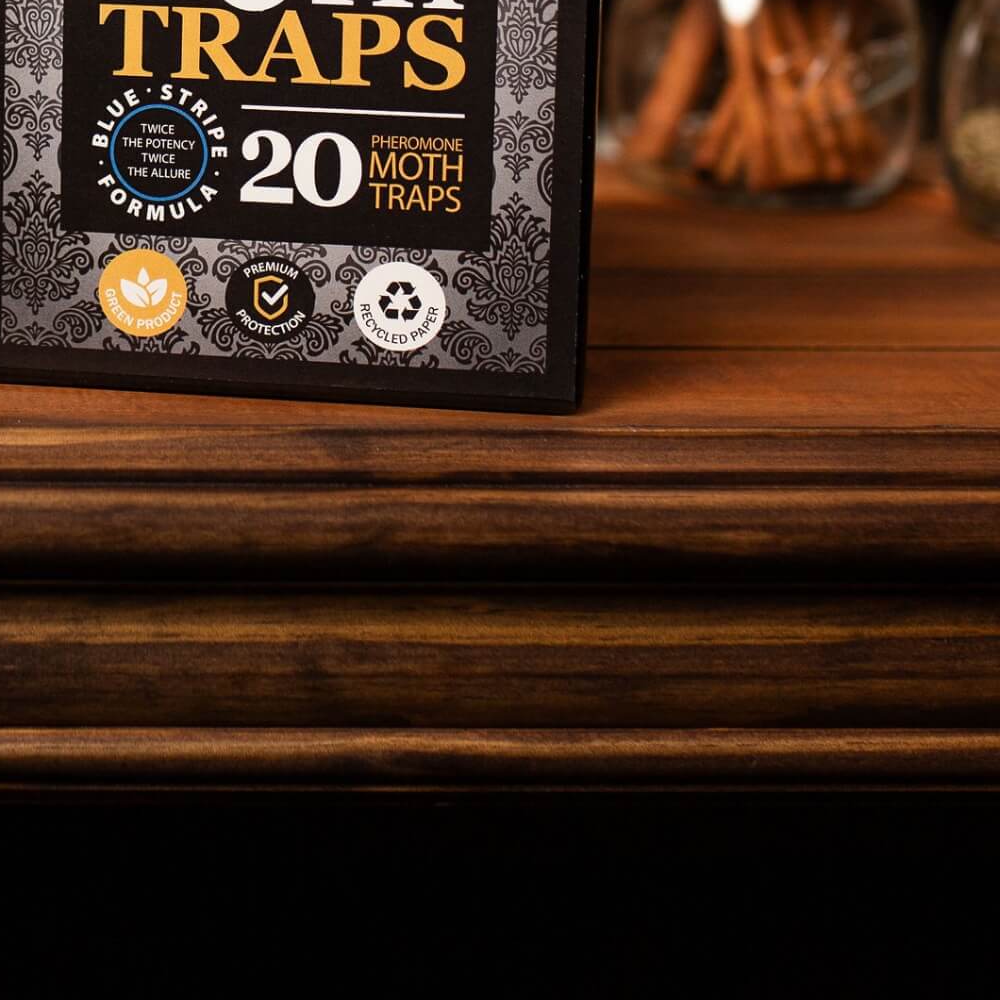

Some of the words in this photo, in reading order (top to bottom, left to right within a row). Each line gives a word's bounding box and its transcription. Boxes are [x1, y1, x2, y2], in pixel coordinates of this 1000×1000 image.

[99, 3, 466, 91] TRAPS
[91, 88, 140, 148] BLUE
[159, 83, 228, 158] STRIPE
[140, 123, 175, 135] TWICE
[122, 136, 143, 148] THE
[145, 138, 196, 150] POTENCY
[141, 152, 176, 164] TWICE
[371, 135, 464, 152] PHEROMONE
[127, 166, 148, 177] THE
[150, 167, 191, 179] ALLURE
[239, 129, 363, 208] 20
[368, 151, 464, 182] MOTH
[97, 174, 219, 222] FORMULA
[368, 183, 462, 213] TRAPS
[243, 261, 299, 280] PREMIUM
[105, 288, 134, 327] GREEN
[136, 291, 182, 329] PRODUCT
[235, 309, 306, 336] PROTECTION
[360, 303, 408, 344] RECYCLED
[410, 306, 439, 341] PAPER
